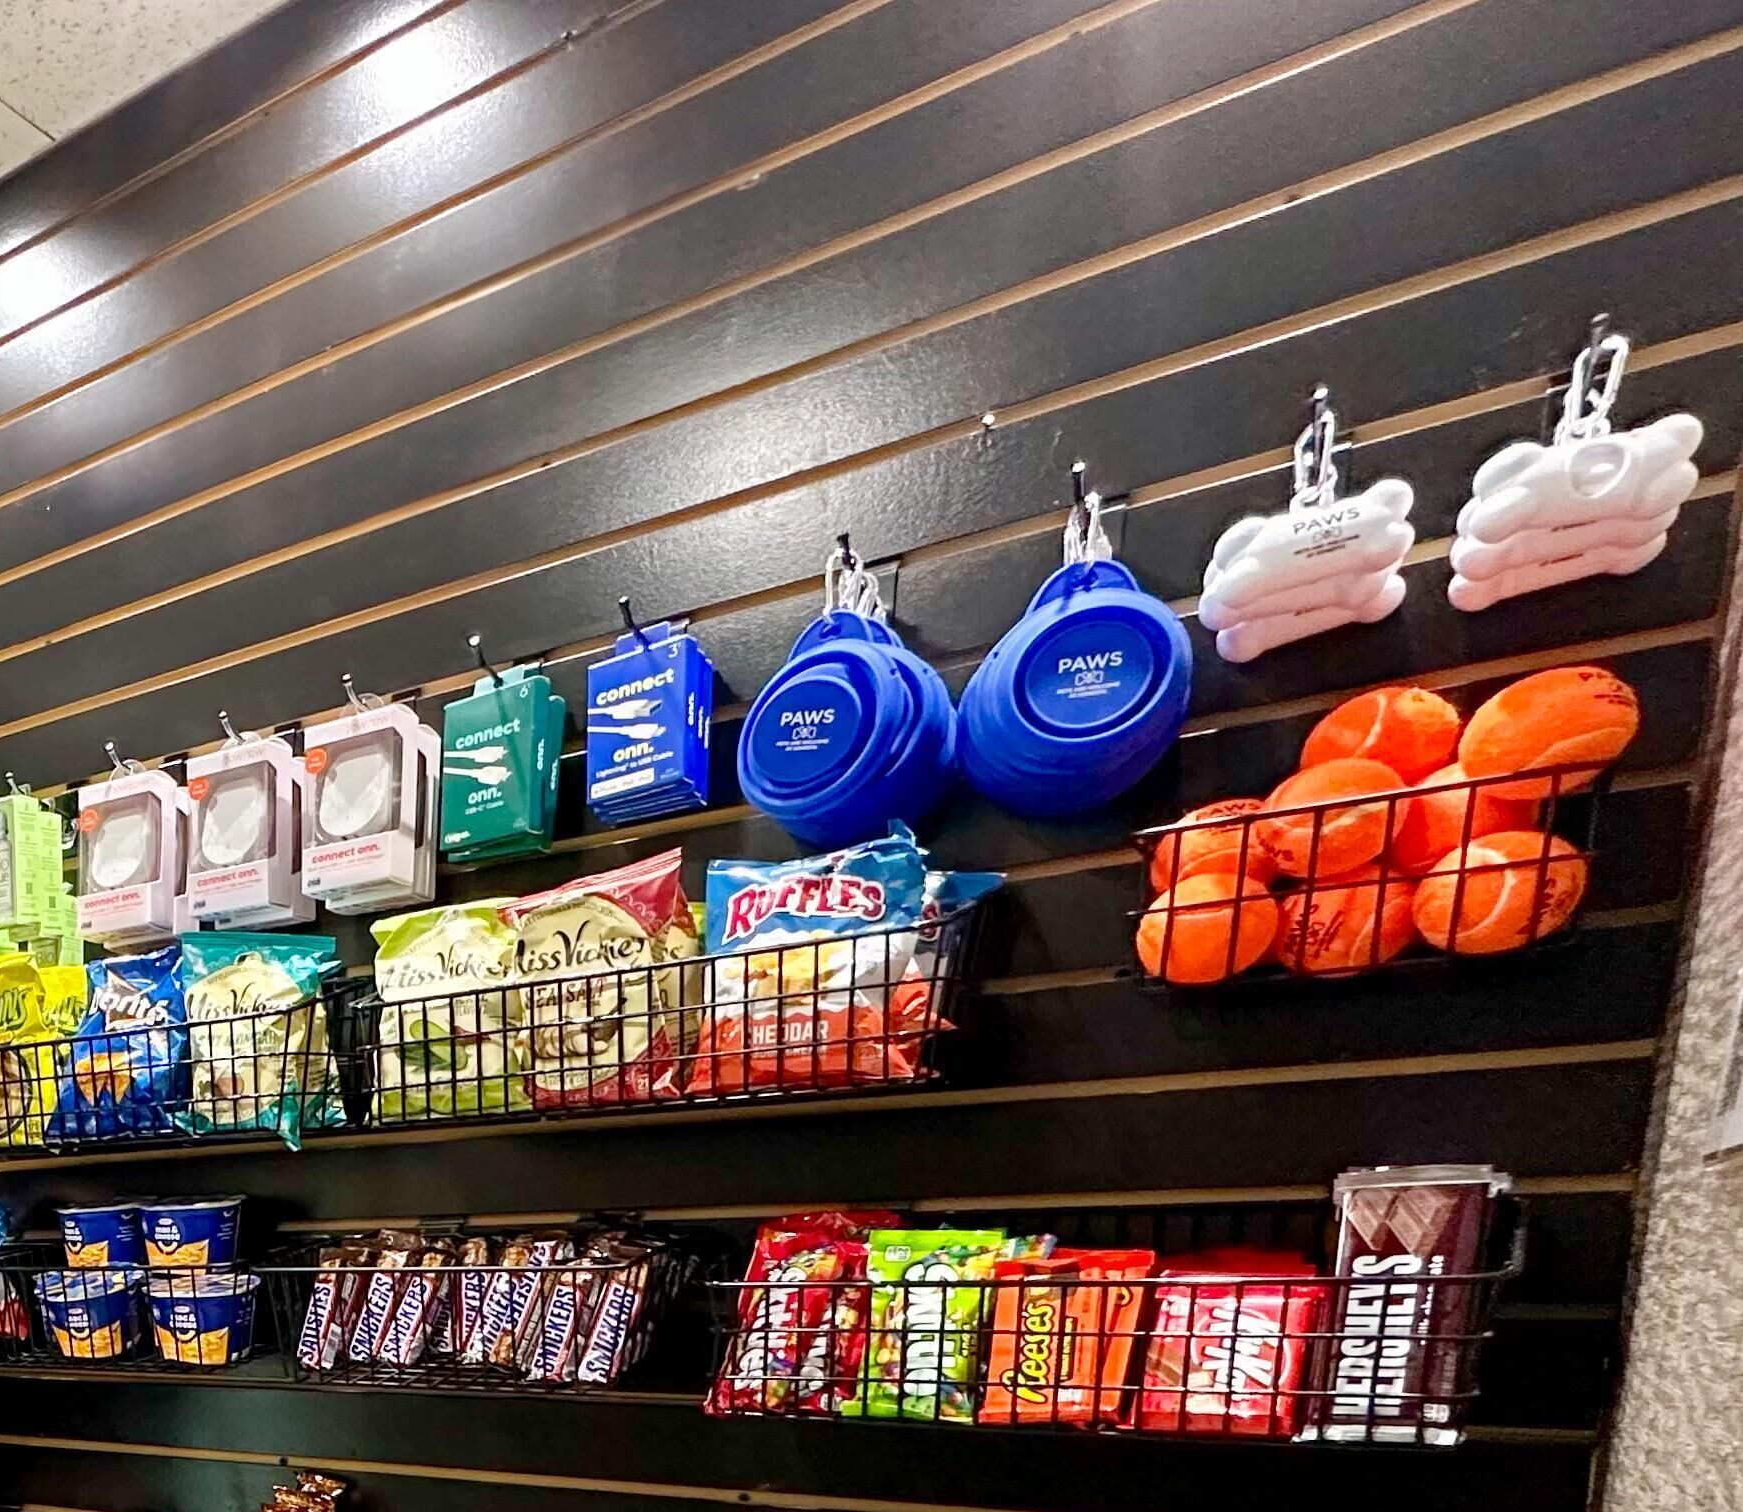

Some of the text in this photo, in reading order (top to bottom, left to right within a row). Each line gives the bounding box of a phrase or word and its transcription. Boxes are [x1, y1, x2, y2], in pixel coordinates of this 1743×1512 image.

[1293, 507, 1360, 534] PAWS
[1058, 651, 1123, 674] PAWS
[596, 668, 675, 706] connect
[780, 708, 835, 727] PAWS
[456, 718, 521, 750] connect
[613, 742, 654, 763] onn.
[468, 786, 502, 805] onn.
[312, 843, 380, 864] connect onn.
[197, 869, 259, 888] connect onn.
[84, 895, 120, 909] connect
[726, 876, 886, 942] RUFFLES
[748, 1020, 829, 1045] HEDAR
